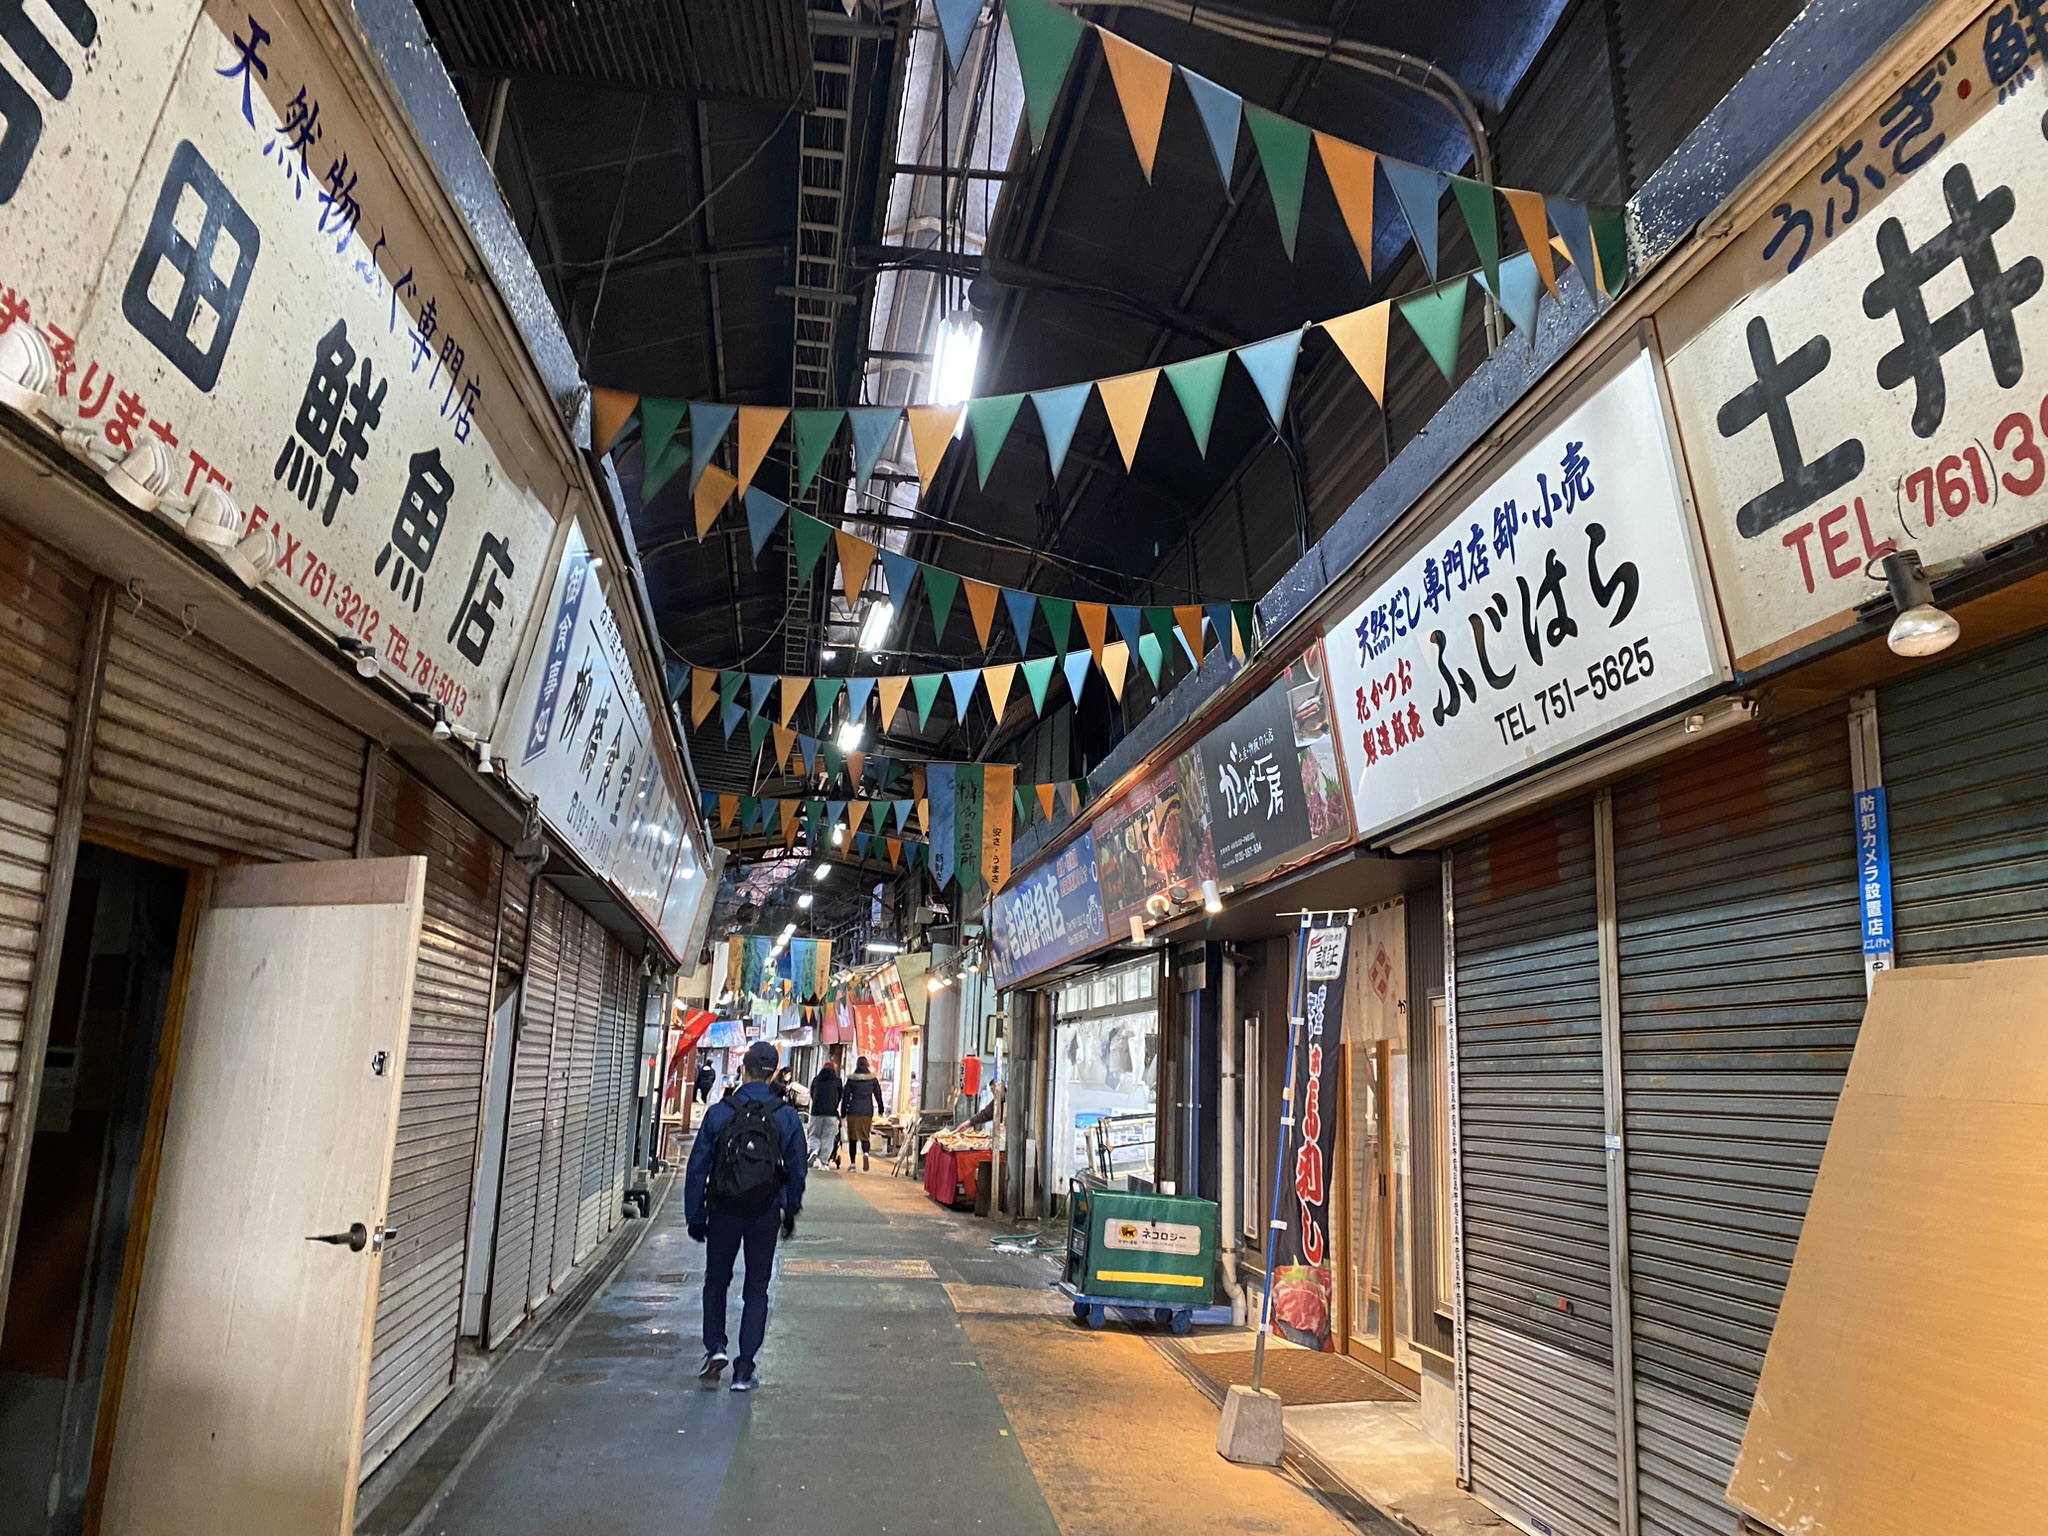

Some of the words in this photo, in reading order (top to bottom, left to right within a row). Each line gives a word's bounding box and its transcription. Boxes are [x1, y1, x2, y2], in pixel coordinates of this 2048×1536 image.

[1783, 496, 1896, 594] TEL
[299, 550, 380, 643] 761-3212
[385, 624, 410, 673] TEL
[411, 650, 467, 717] 781-5013
[532, 564, 584, 749] 御食事処
[1431, 522, 1640, 727] ふじはら
[559, 645, 636, 828] 柳橋食堂
[1355, 658, 1413, 724] 花かつお
[1362, 701, 1425, 768] 製造販売
[1494, 709, 1536, 746] TEL
[1535, 636, 1655, 726] 751-5625
[1005, 873, 1066, 961] 吉田鮮魚店
[1860, 795, 1884, 937] 防犯カメラ設置店
[1142, 1227, 1187, 1241] ネコロジー
